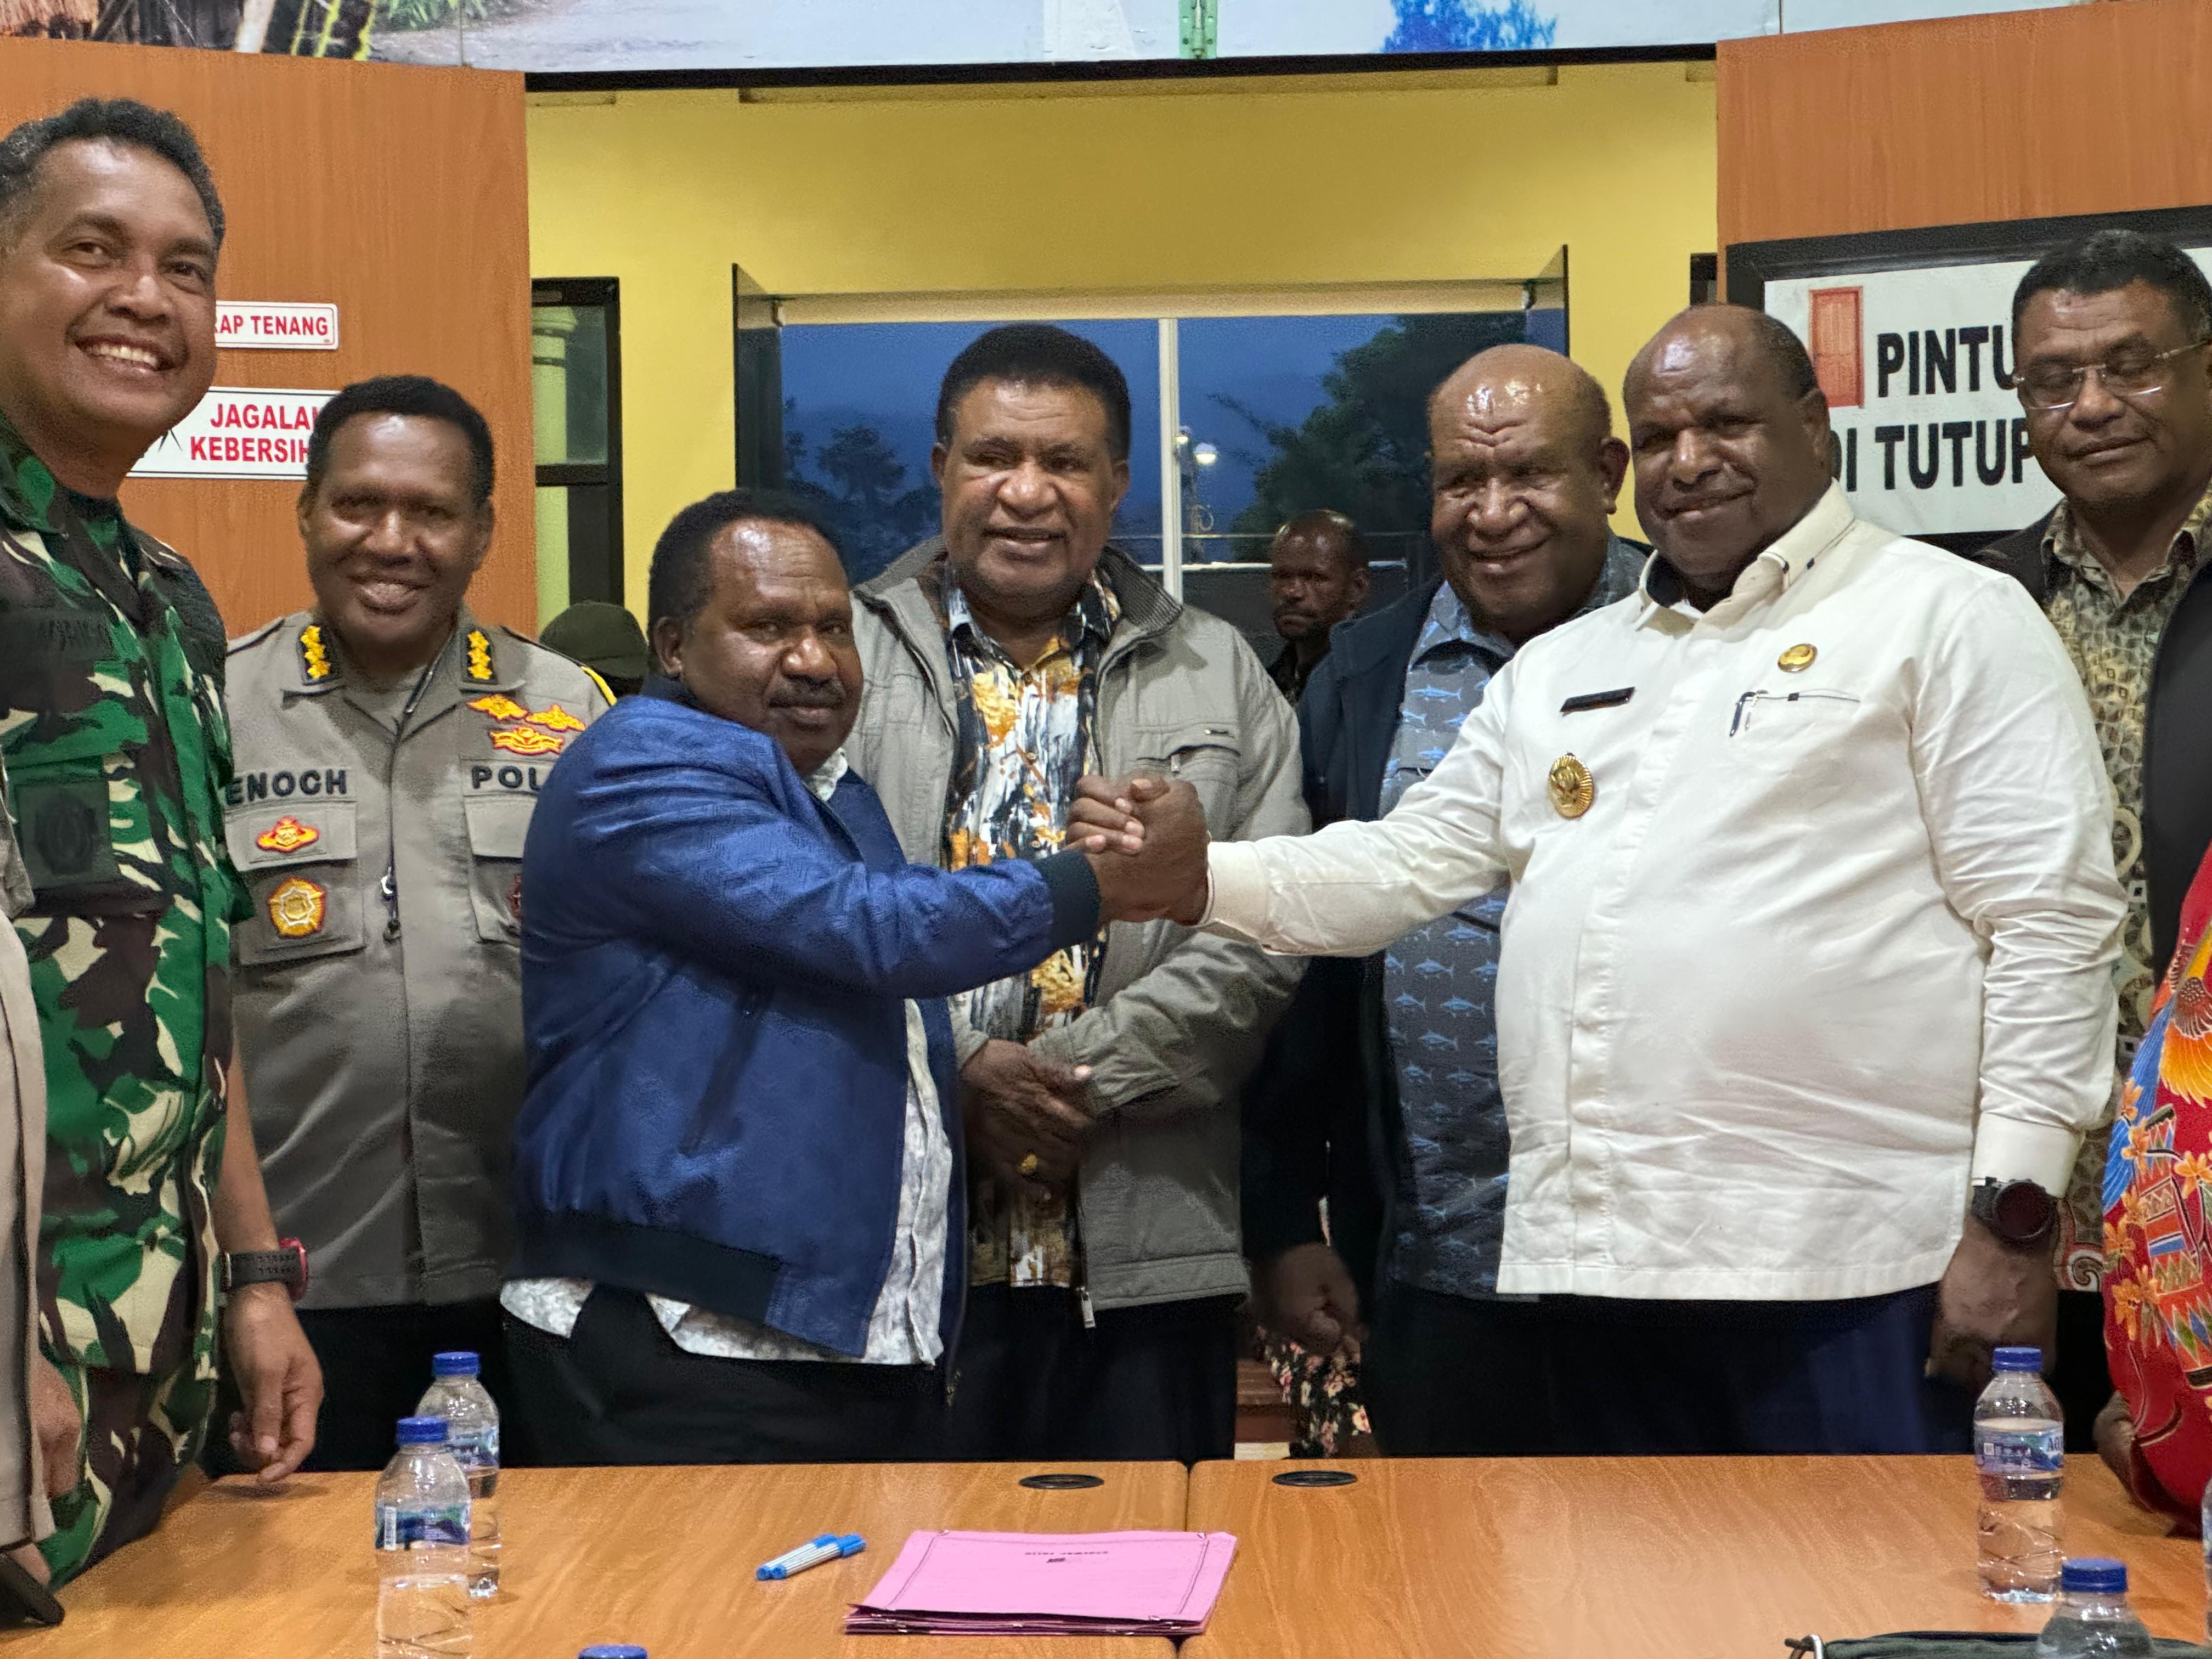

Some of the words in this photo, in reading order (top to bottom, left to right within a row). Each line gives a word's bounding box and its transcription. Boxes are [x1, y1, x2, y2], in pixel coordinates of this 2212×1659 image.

[215, 315, 244, 334] AP
[251, 316, 328, 336] TENANG
[1877, 325, 2018, 398] PINTU
[1875, 417, 2034, 490] TUTUP
